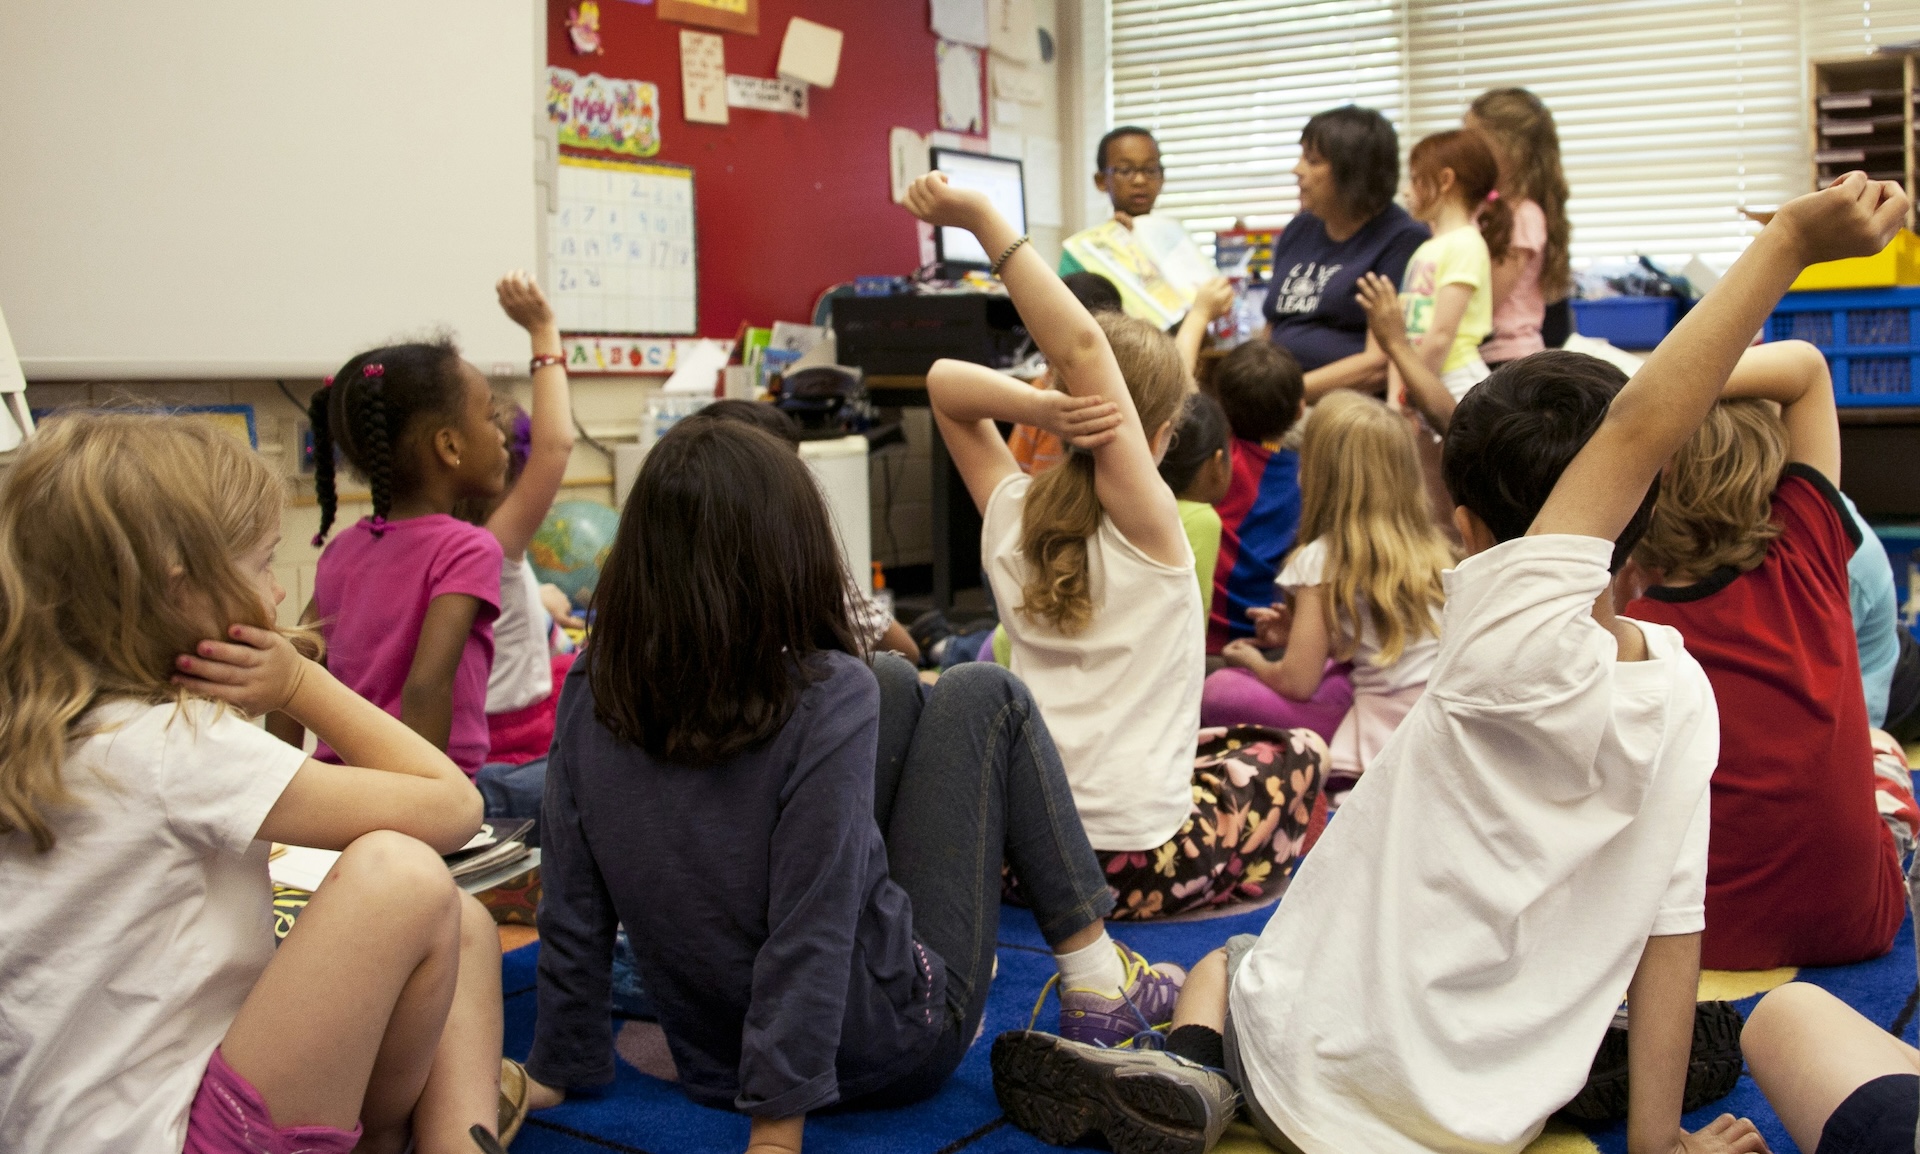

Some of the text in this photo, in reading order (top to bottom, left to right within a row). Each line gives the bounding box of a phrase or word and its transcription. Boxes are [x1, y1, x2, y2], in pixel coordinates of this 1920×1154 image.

[631, 177, 649, 197] 2
[583, 206, 596, 223] 7
[651, 240, 670, 269] 17
[571, 344, 661, 365] A B C
